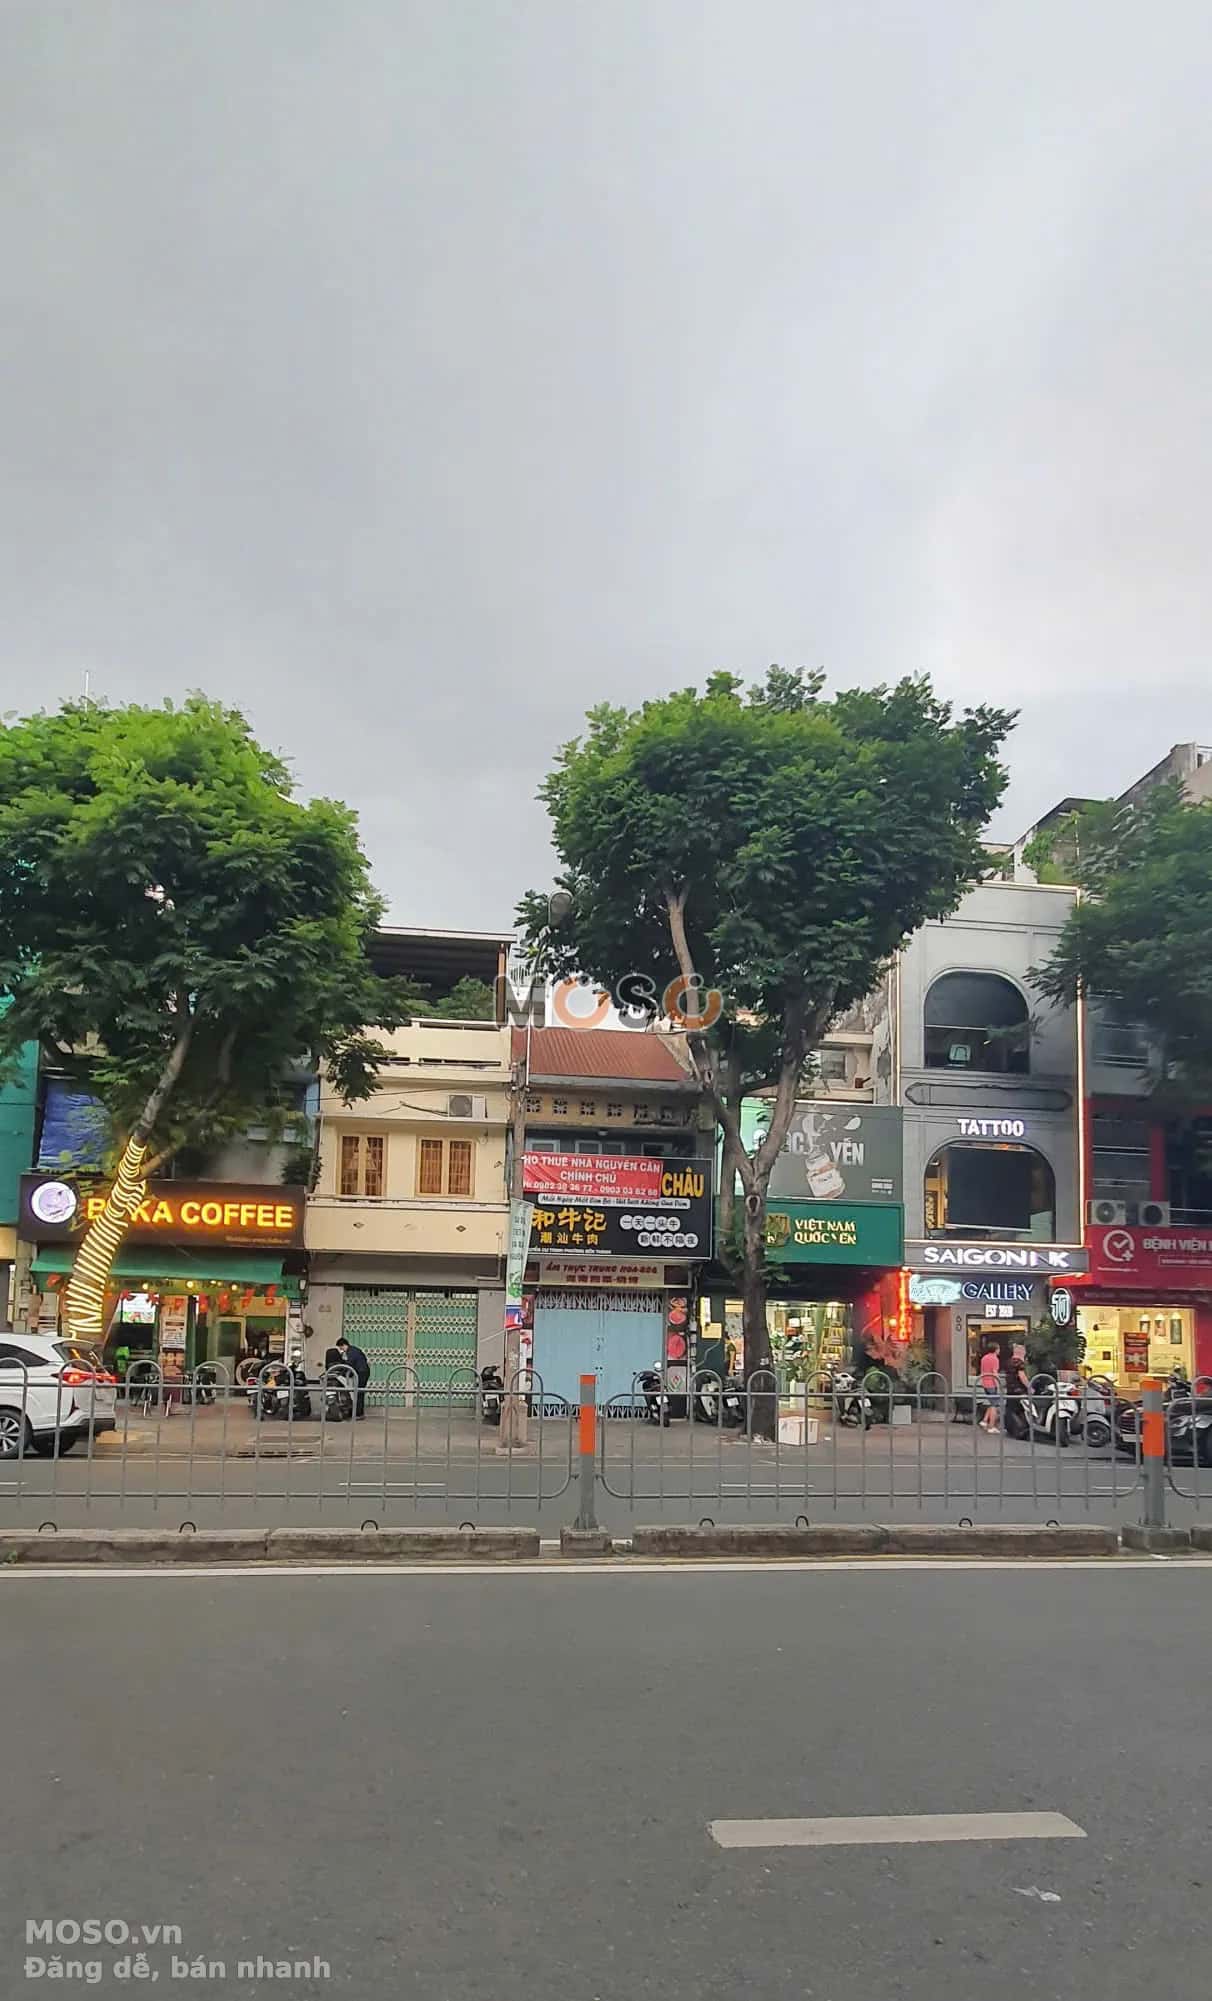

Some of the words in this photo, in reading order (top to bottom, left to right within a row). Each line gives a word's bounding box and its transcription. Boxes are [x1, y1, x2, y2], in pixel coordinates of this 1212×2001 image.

[957, 1119, 1026, 1137] TATTOO
[661, 1167, 706, 1197] CHÂU
[87, 1198, 174, 1224] BKA
[180, 1201, 293, 1228] COFFEE
[827, 1220, 857, 1233] NAM
[962, 1282, 1034, 1301] GALLERY
